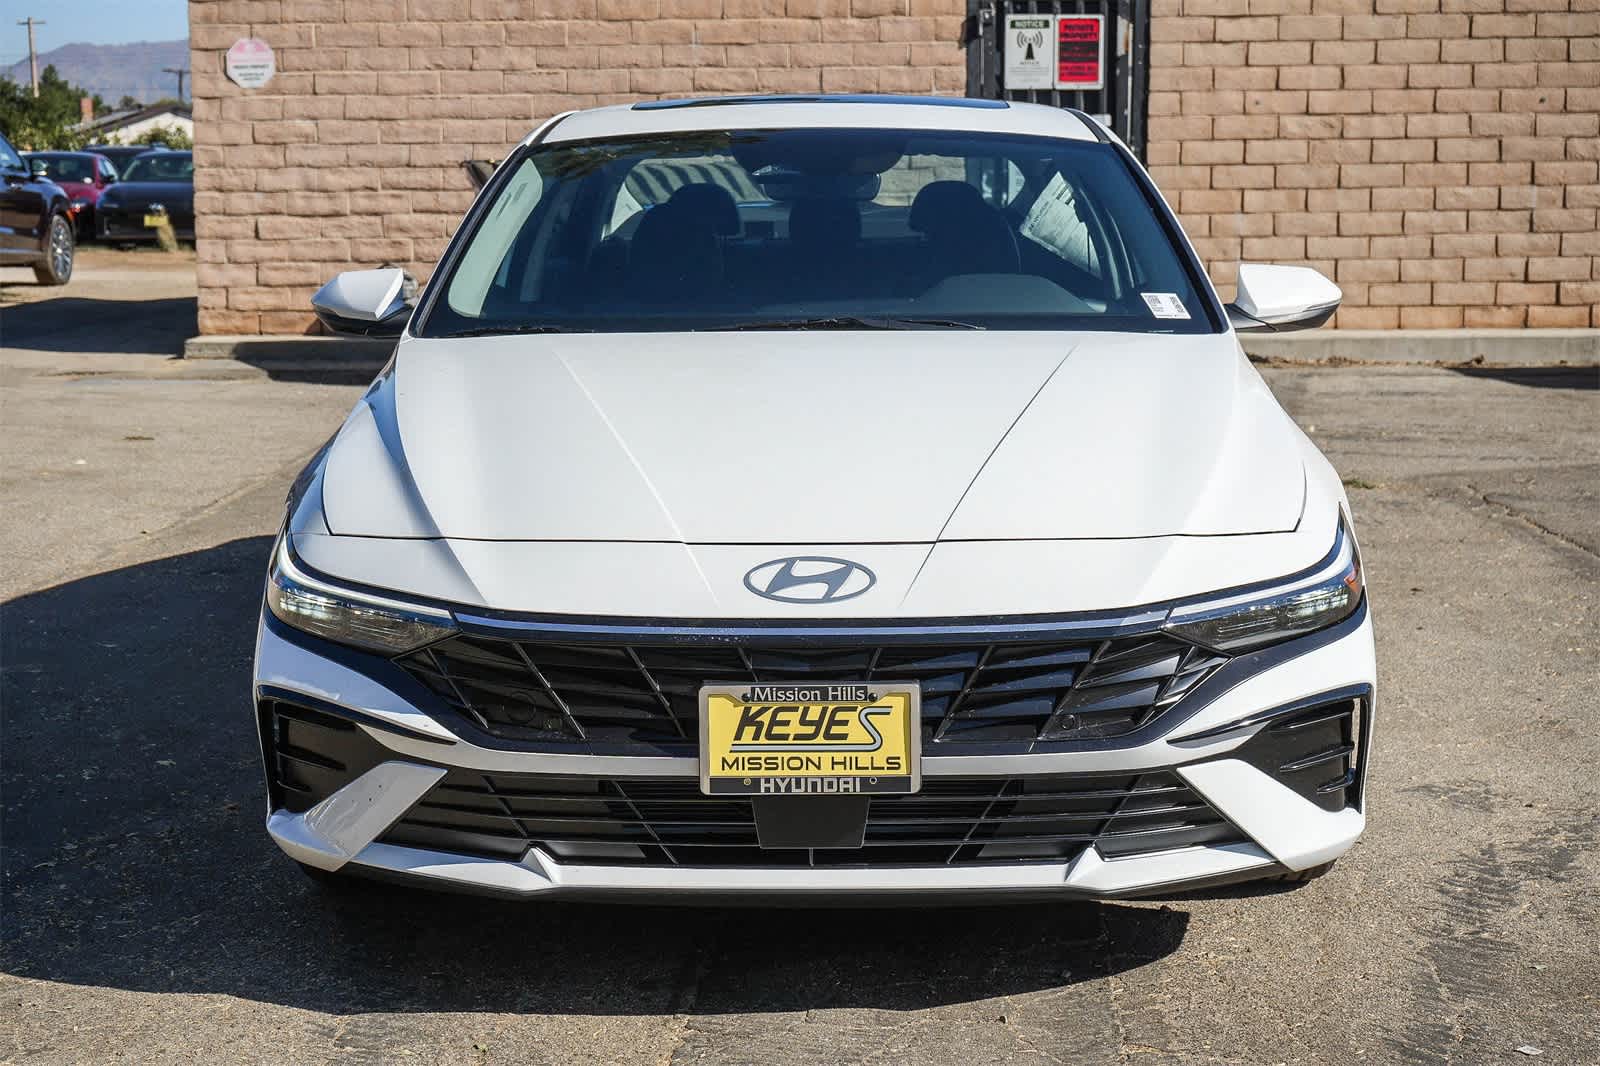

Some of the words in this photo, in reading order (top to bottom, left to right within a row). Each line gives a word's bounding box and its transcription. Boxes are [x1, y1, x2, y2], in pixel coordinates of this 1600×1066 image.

[1015, 20, 1045, 28] NOTICE
[753, 686, 820, 702] Mission
[828, 686, 865, 702] Hills
[731, 705, 893, 752] KEYES
[721, 756, 822, 771] MISSION
[831, 756, 901, 771] HILLS
[760, 777, 861, 793] HYUNDAI
